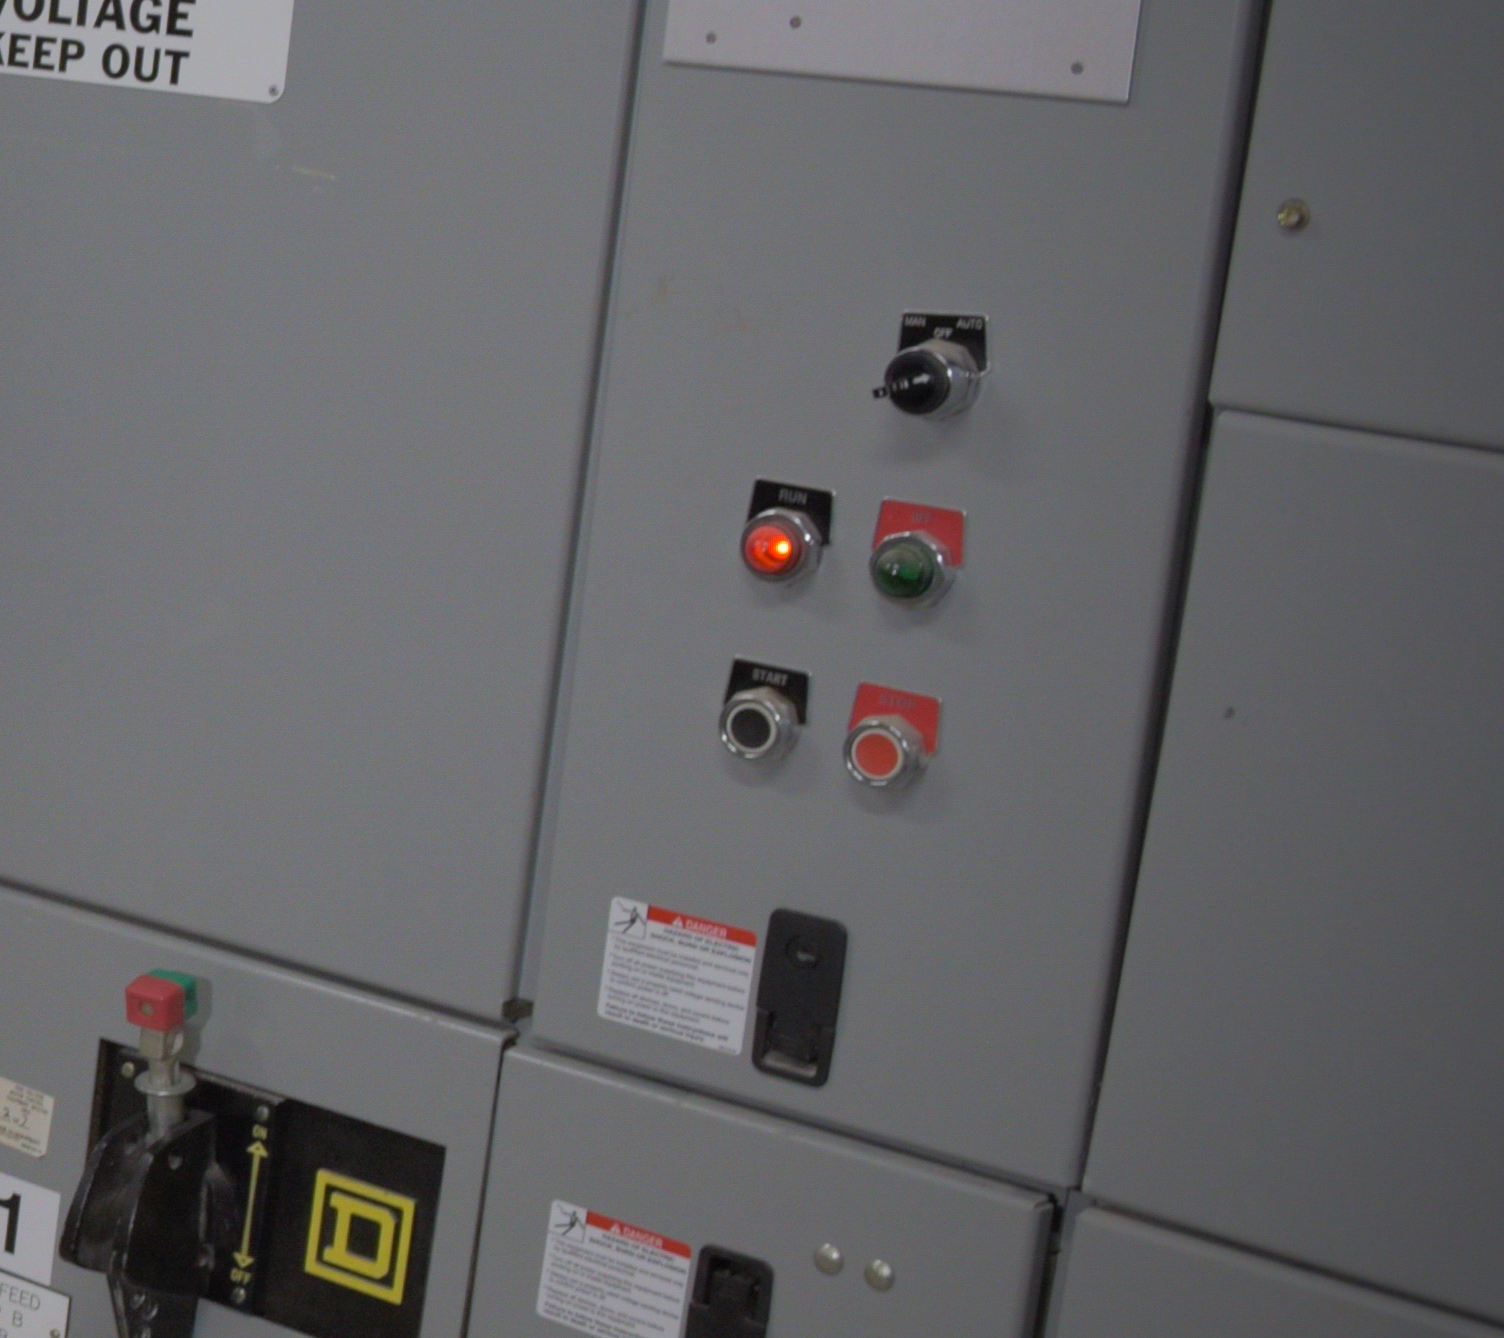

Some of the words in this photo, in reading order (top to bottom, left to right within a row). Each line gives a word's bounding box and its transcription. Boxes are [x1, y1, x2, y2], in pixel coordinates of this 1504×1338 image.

[101, 43, 191, 87] OUT
[904, 316, 926, 328] MAN
[956, 317, 982, 330] AUTO
[779, 487, 807, 505] RUN
[751, 668, 788, 687] START
[685, 919, 727, 939] DANGER
[252, 1123, 268, 1141] ON
[623, 1226, 664, 1248] DANGER
[229, 1267, 252, 1285] OFF
[12, 1311, 24, 1328] B
